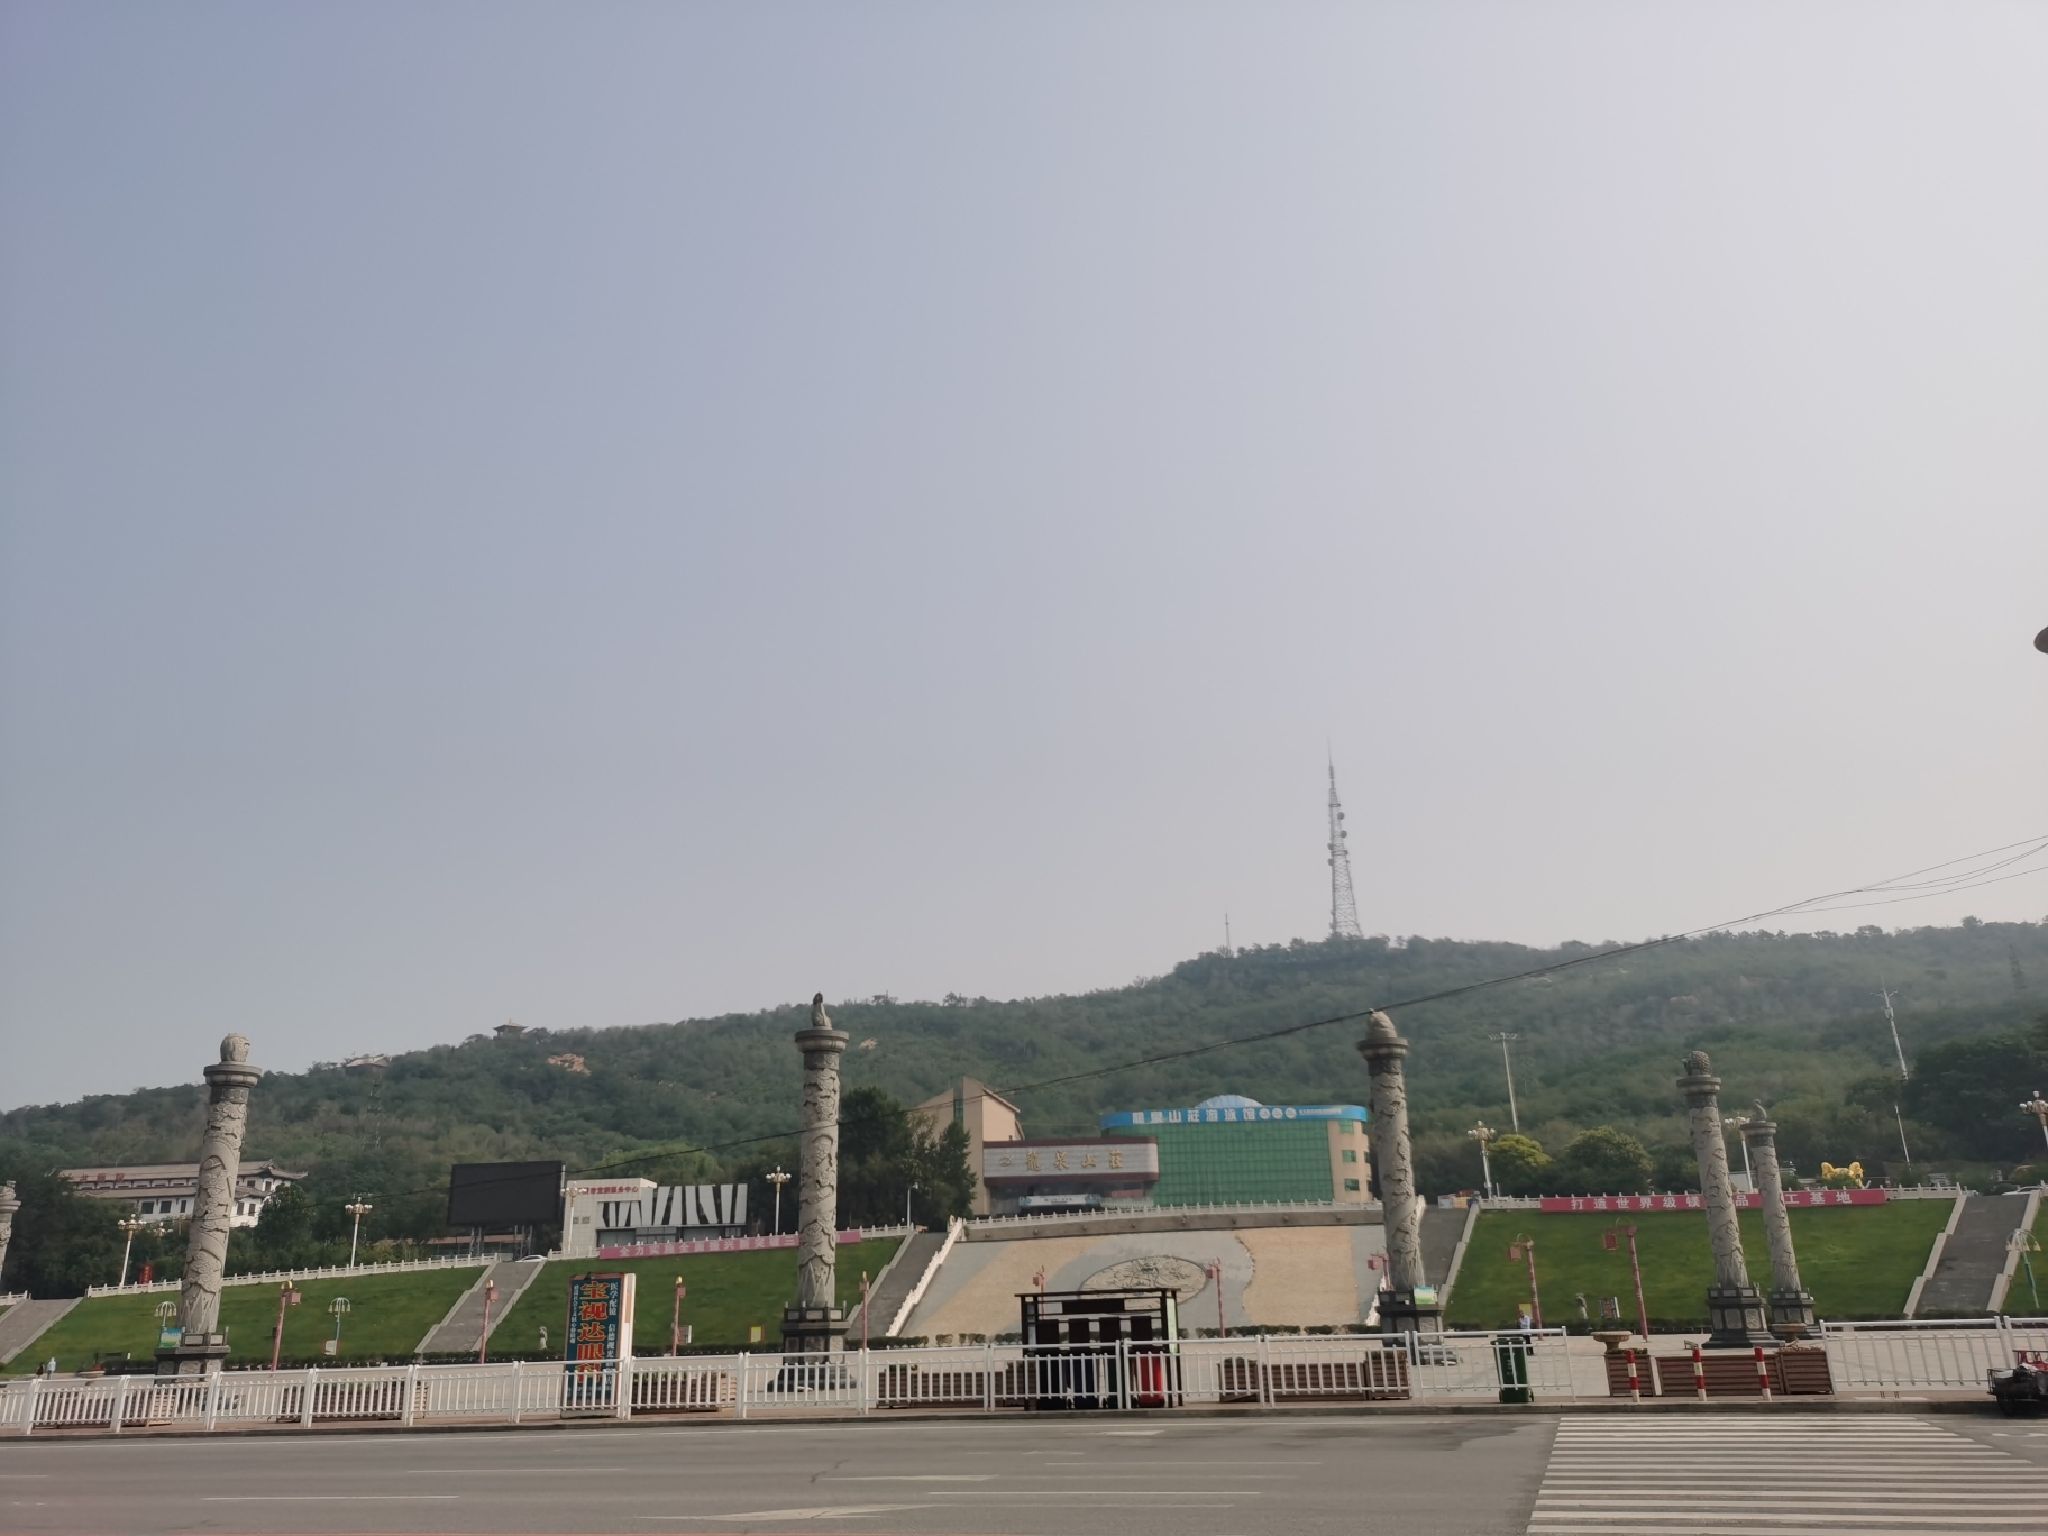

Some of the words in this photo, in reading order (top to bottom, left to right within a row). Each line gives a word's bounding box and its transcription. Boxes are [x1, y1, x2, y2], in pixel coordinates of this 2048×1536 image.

[1571, 1191, 1853, 1210] 打造世界级镁品工基地
